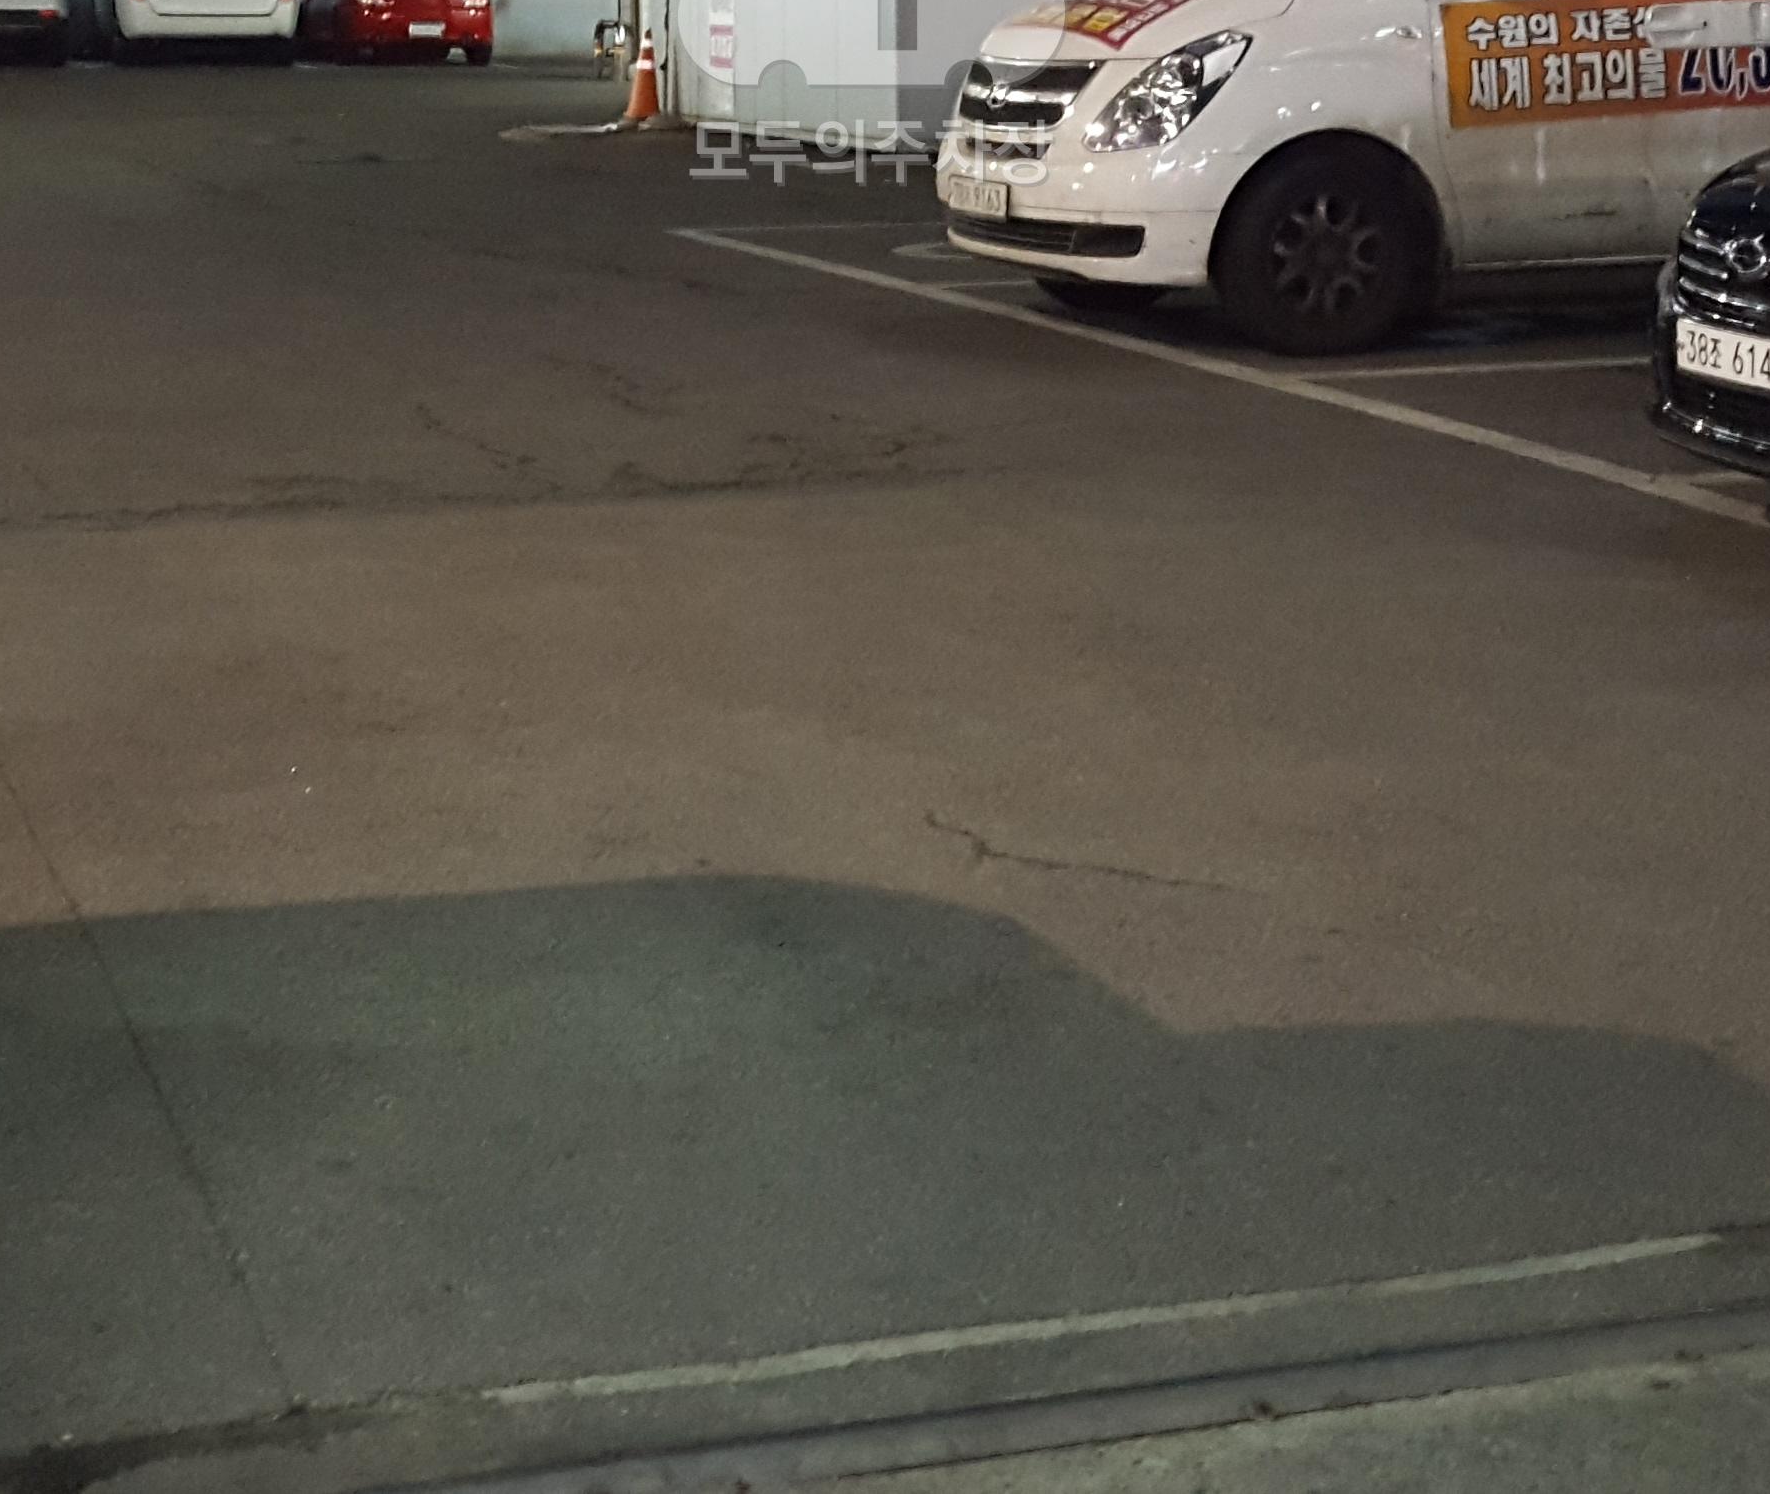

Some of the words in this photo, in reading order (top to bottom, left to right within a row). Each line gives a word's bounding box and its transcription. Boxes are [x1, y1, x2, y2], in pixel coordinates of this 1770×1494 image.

[1466, 11, 1559, 51] 수원의
[1570, 5, 1650, 44] 자존
[1469, 55, 1530, 111] 세계
